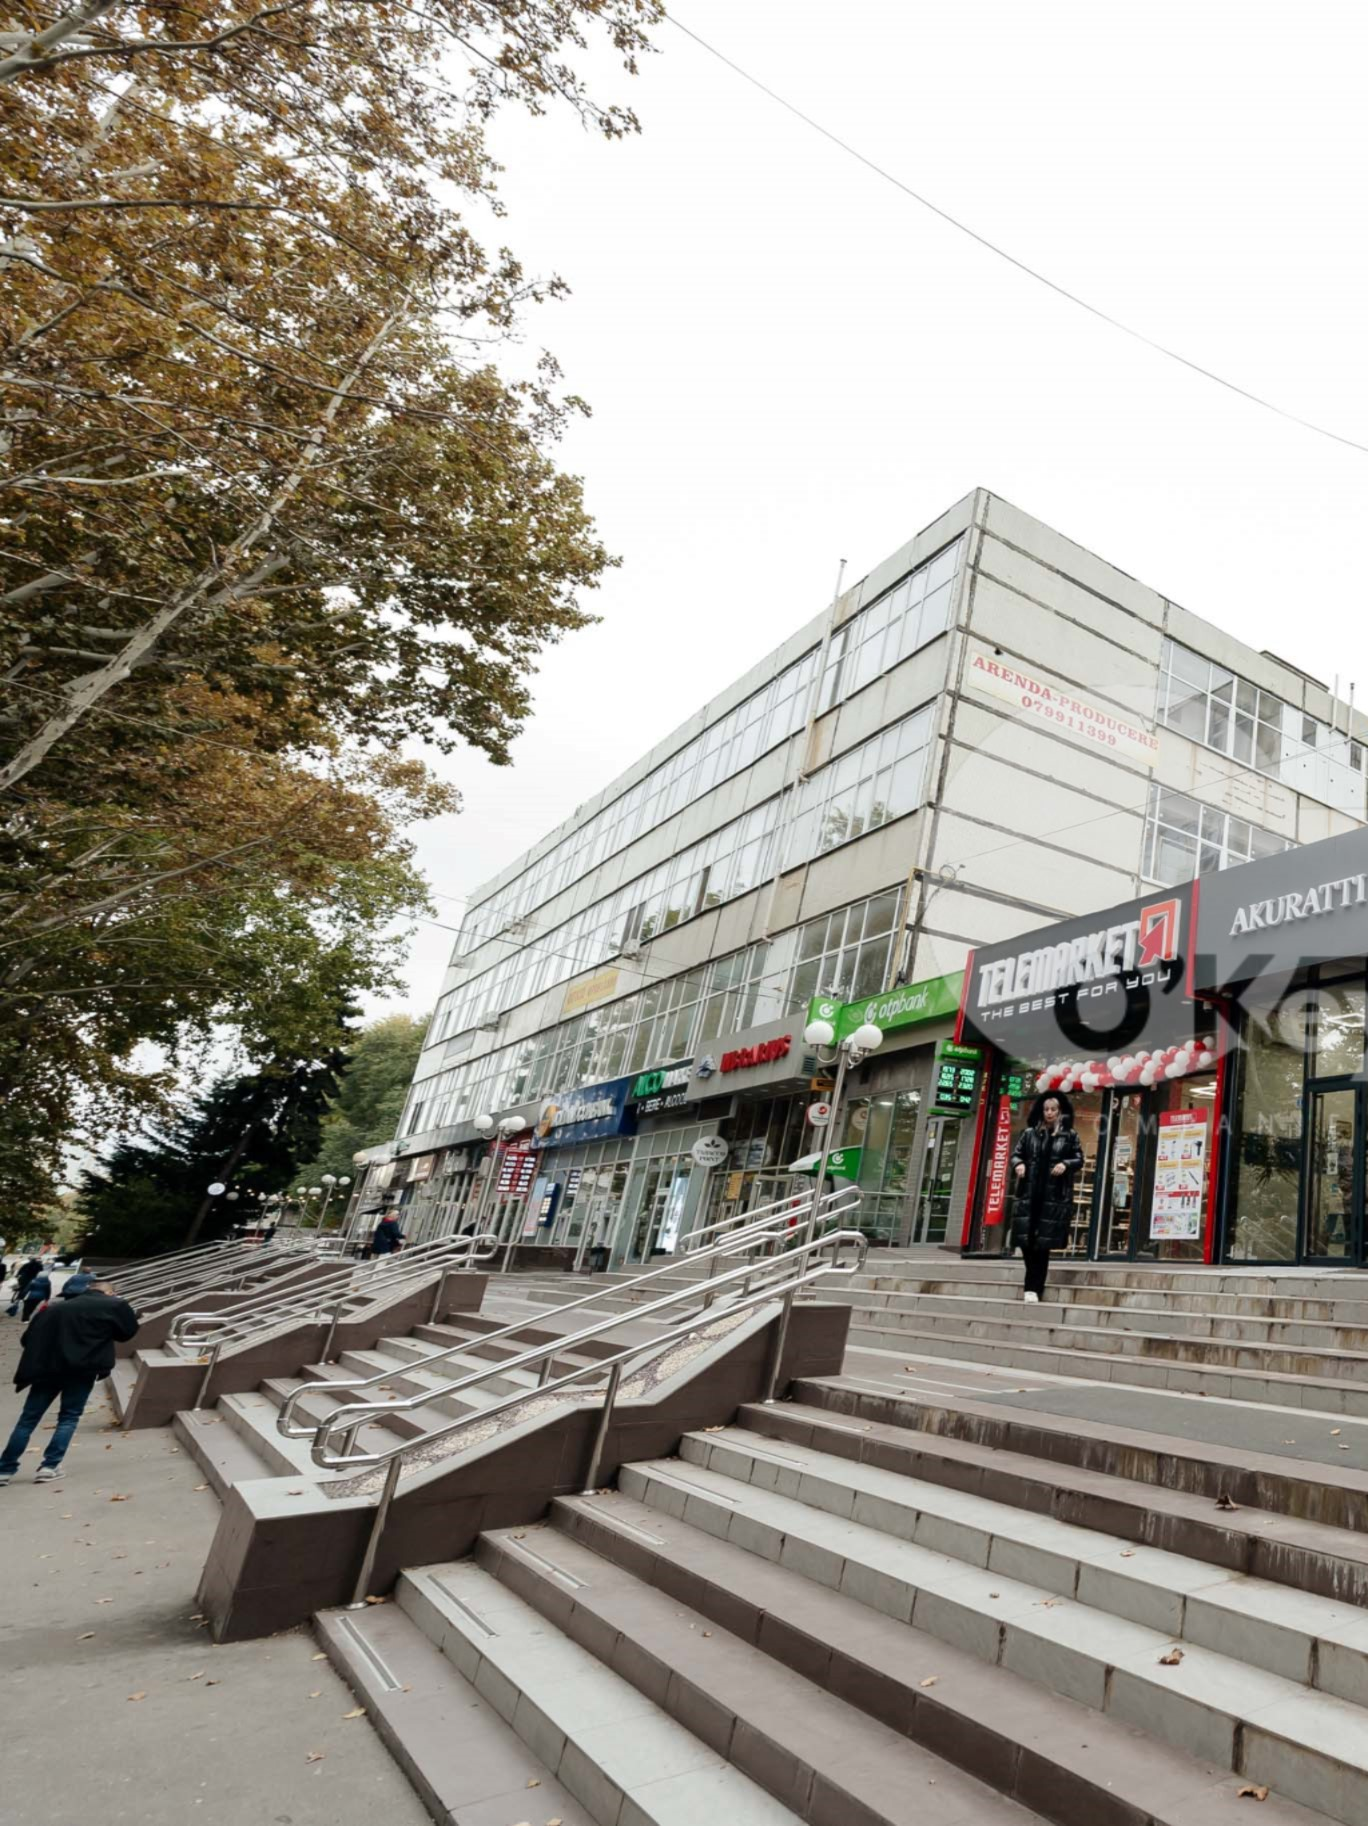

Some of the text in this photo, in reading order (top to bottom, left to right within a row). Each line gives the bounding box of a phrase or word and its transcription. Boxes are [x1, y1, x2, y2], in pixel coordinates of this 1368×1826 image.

[973, 656, 1159, 750] ARENDA-PRODUCERE
[1021, 695, 1117, 746] 079911399
[1228, 873, 1368, 936] AKURATTI
[977, 920, 1141, 1008] TELEMARKET
[980, 968, 1171, 1022] THE BEST FOR YOU
[879, 985, 929, 1022] otpbank
[987, 1126, 1009, 1214] TELEMARKET
